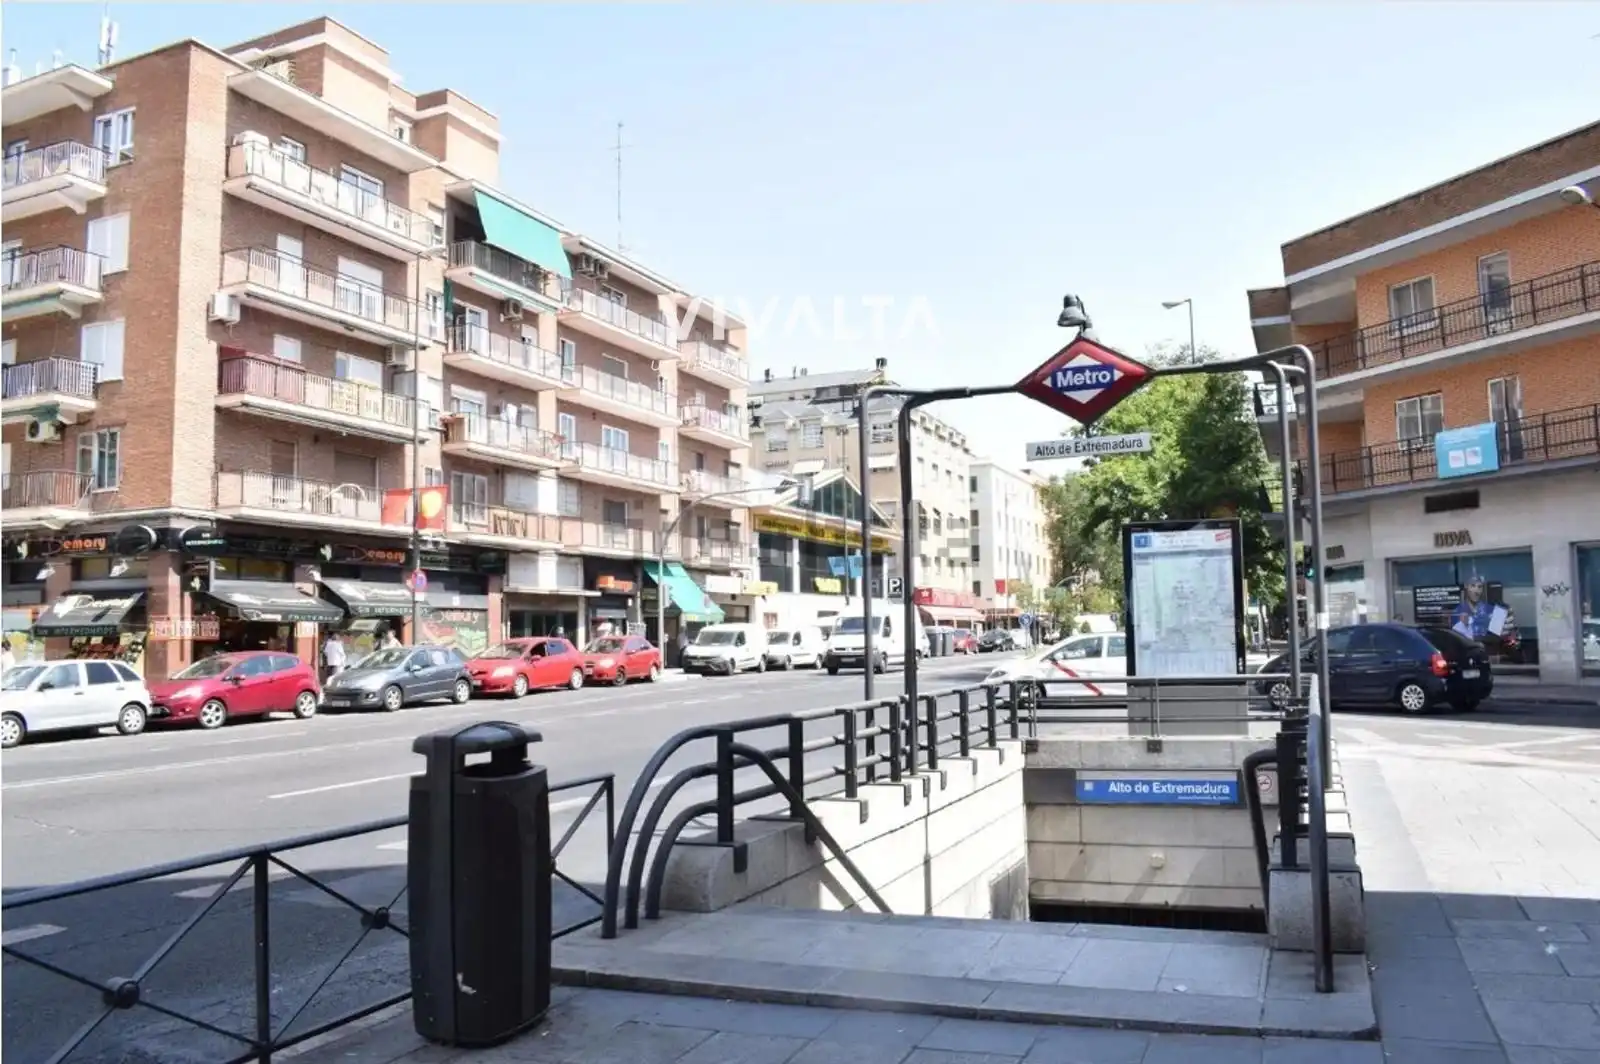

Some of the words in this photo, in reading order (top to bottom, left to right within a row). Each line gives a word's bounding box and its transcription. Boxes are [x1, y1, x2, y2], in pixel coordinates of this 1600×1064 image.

[1056, 369, 1111, 388] Metro
[1035, 444, 1056, 457] Alto
[1058, 443, 1072, 454] de
[1074, 437, 1144, 453] Extremadura
[1108, 781, 1132, 794] Alto
[1134, 781, 1150, 794] de
[1152, 781, 1230, 794] Extremadura
